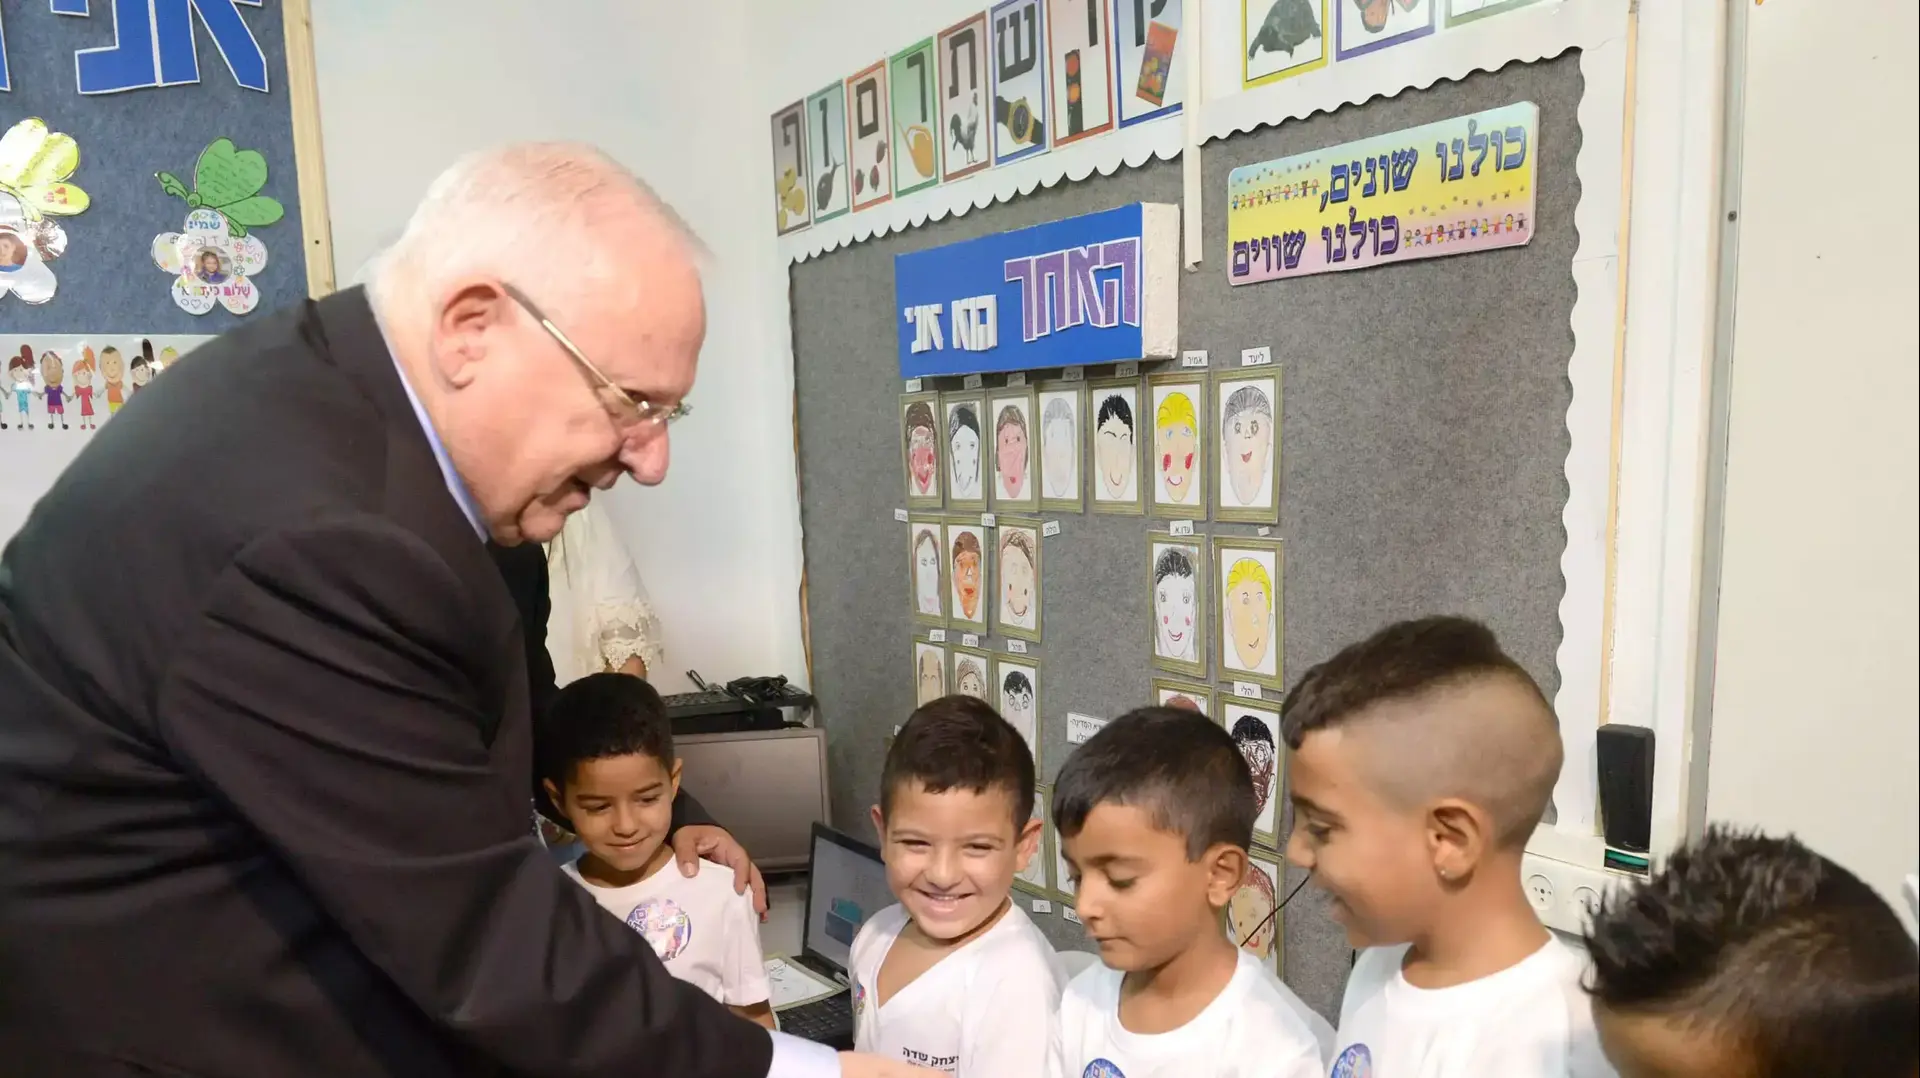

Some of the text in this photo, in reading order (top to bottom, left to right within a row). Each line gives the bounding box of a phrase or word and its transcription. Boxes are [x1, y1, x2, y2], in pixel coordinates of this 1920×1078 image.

[948, 27, 978, 99] ת
[996, 3, 1037, 84] ש
[1319, 118, 1527, 213] כולנו שונים,
[1232, 206, 1400, 277] כולנו שווים
[1004, 236, 1140, 343] האחר
[904, 303, 944, 354] אני
[902, 1046, 929, 1062] שדה
